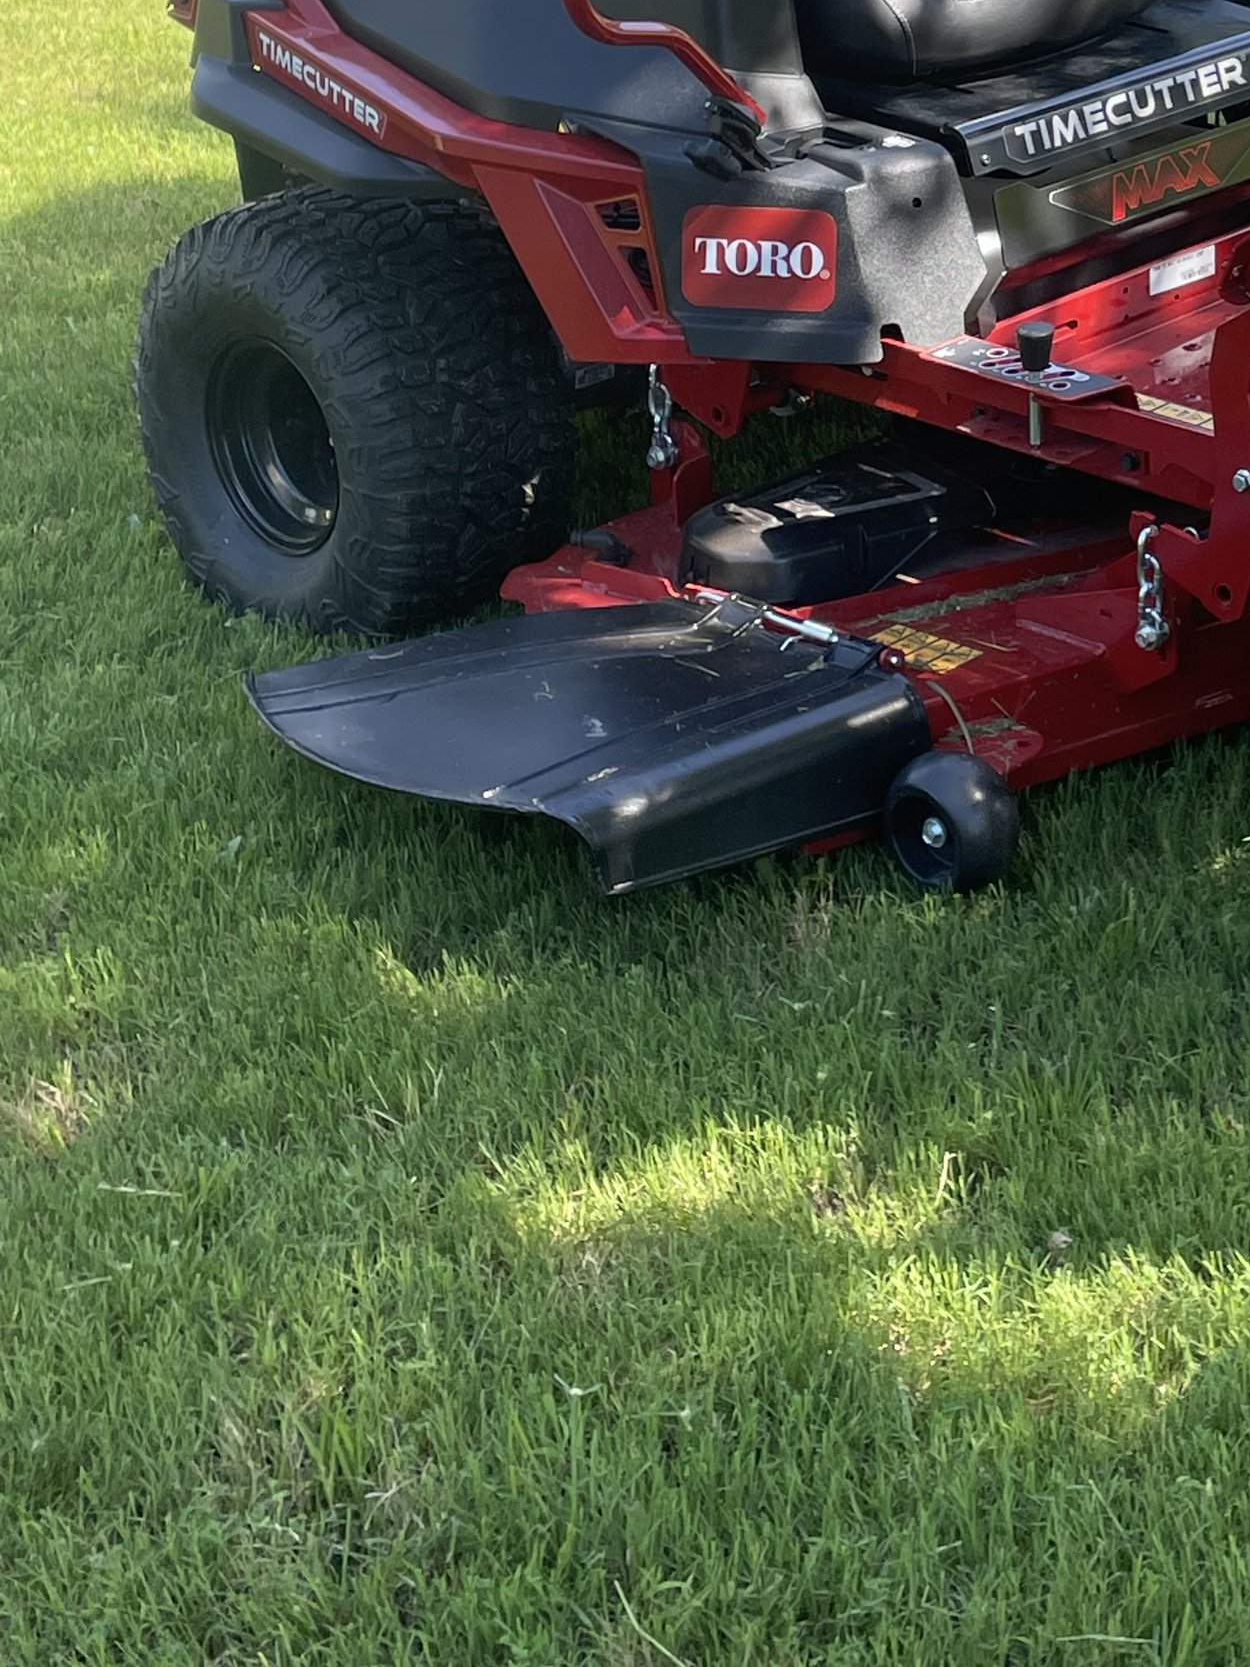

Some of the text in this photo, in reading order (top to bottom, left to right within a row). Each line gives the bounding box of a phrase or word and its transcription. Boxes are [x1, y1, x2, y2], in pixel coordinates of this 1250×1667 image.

[258, 32, 380, 133] TIMECUTTER
[1014, 56, 1248, 155] TIMECUTTER
[1112, 140, 1221, 223] MAX
